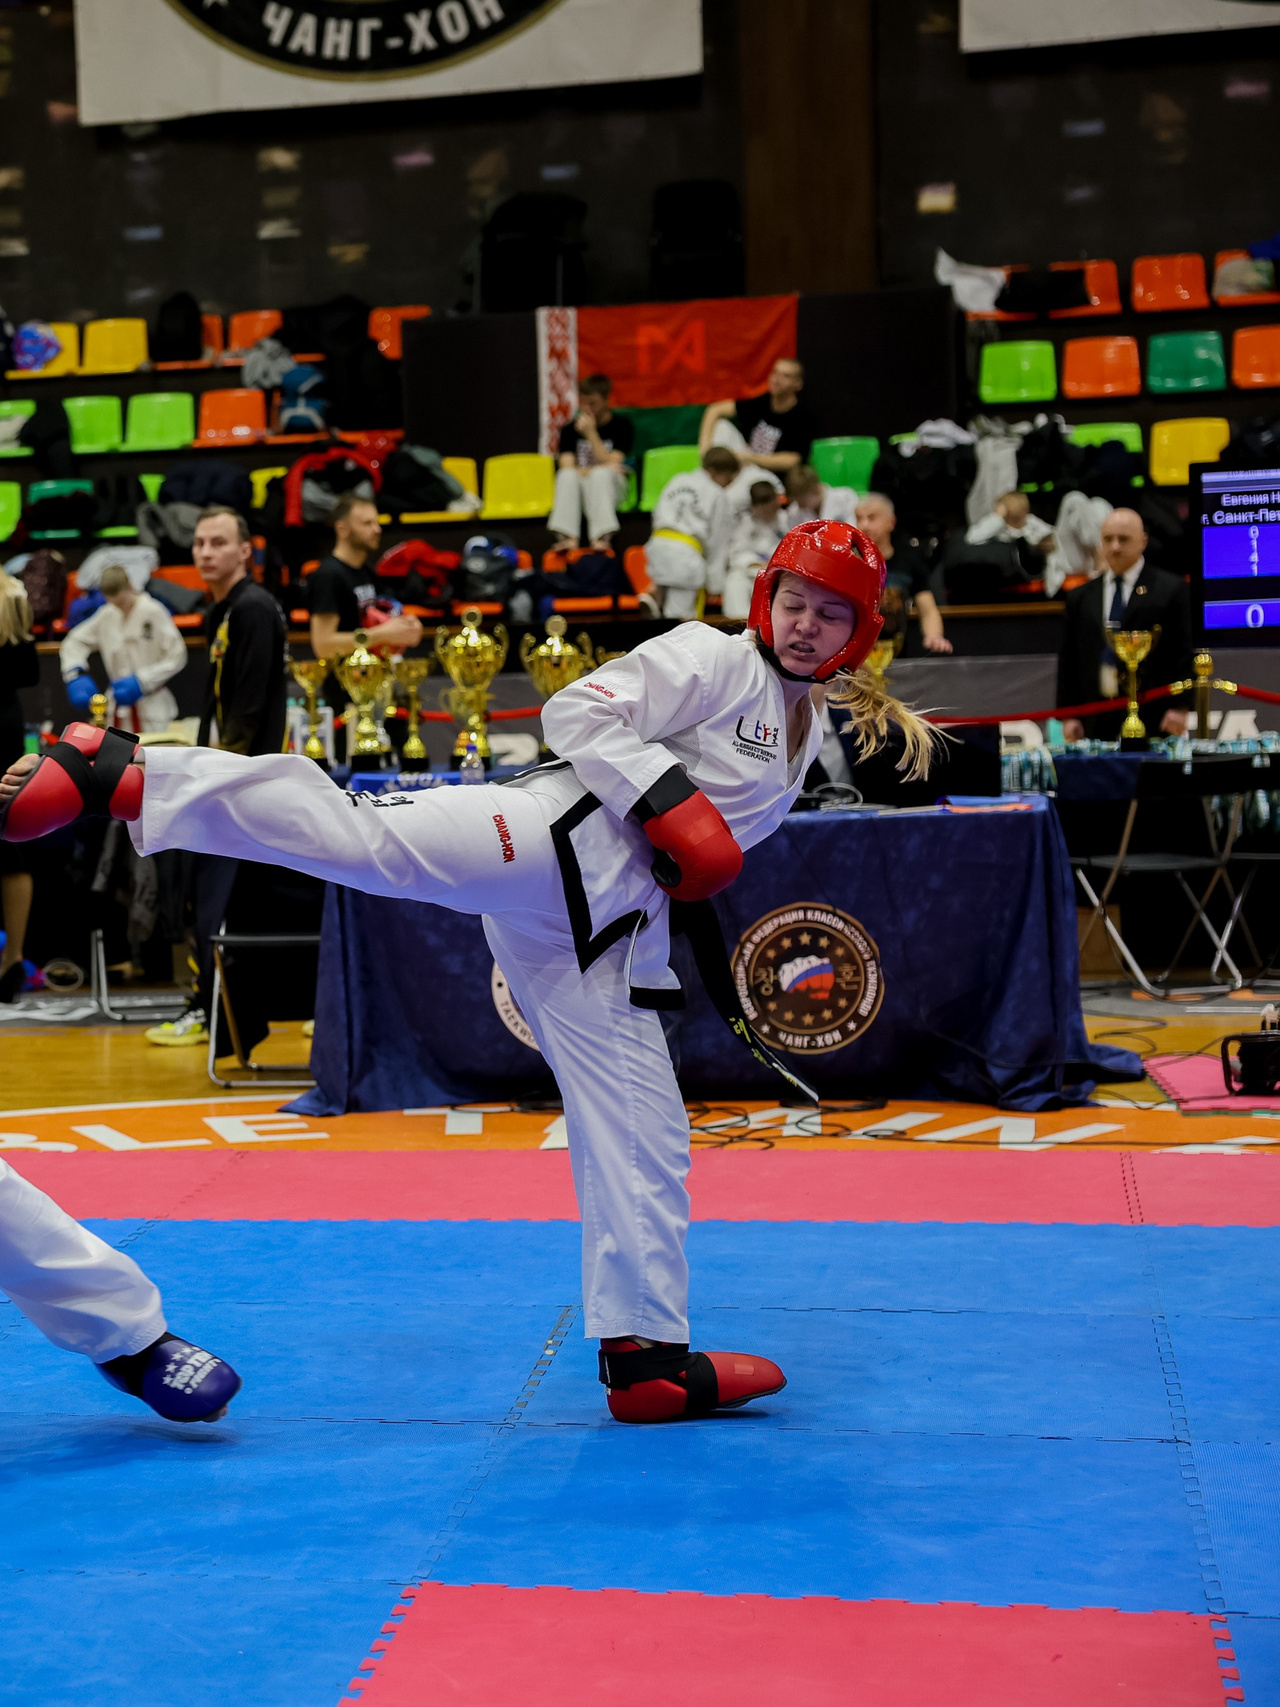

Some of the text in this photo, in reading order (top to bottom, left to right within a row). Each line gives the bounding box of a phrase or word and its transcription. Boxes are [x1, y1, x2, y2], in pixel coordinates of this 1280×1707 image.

[262, 0, 505, 60] ЧАНГ-ХОН
[1221, 494, 1269, 506] Евгения
[1245, 604, 1264, 628] 0
[736, 748, 770, 763] FEDERATION
[492, 814, 516, 863] CHANG-HON
[750, 909, 805, 942] ФЕДЕРАЦИЯ
[778, 1029, 842, 1048] ЧАНГ-ХОН
